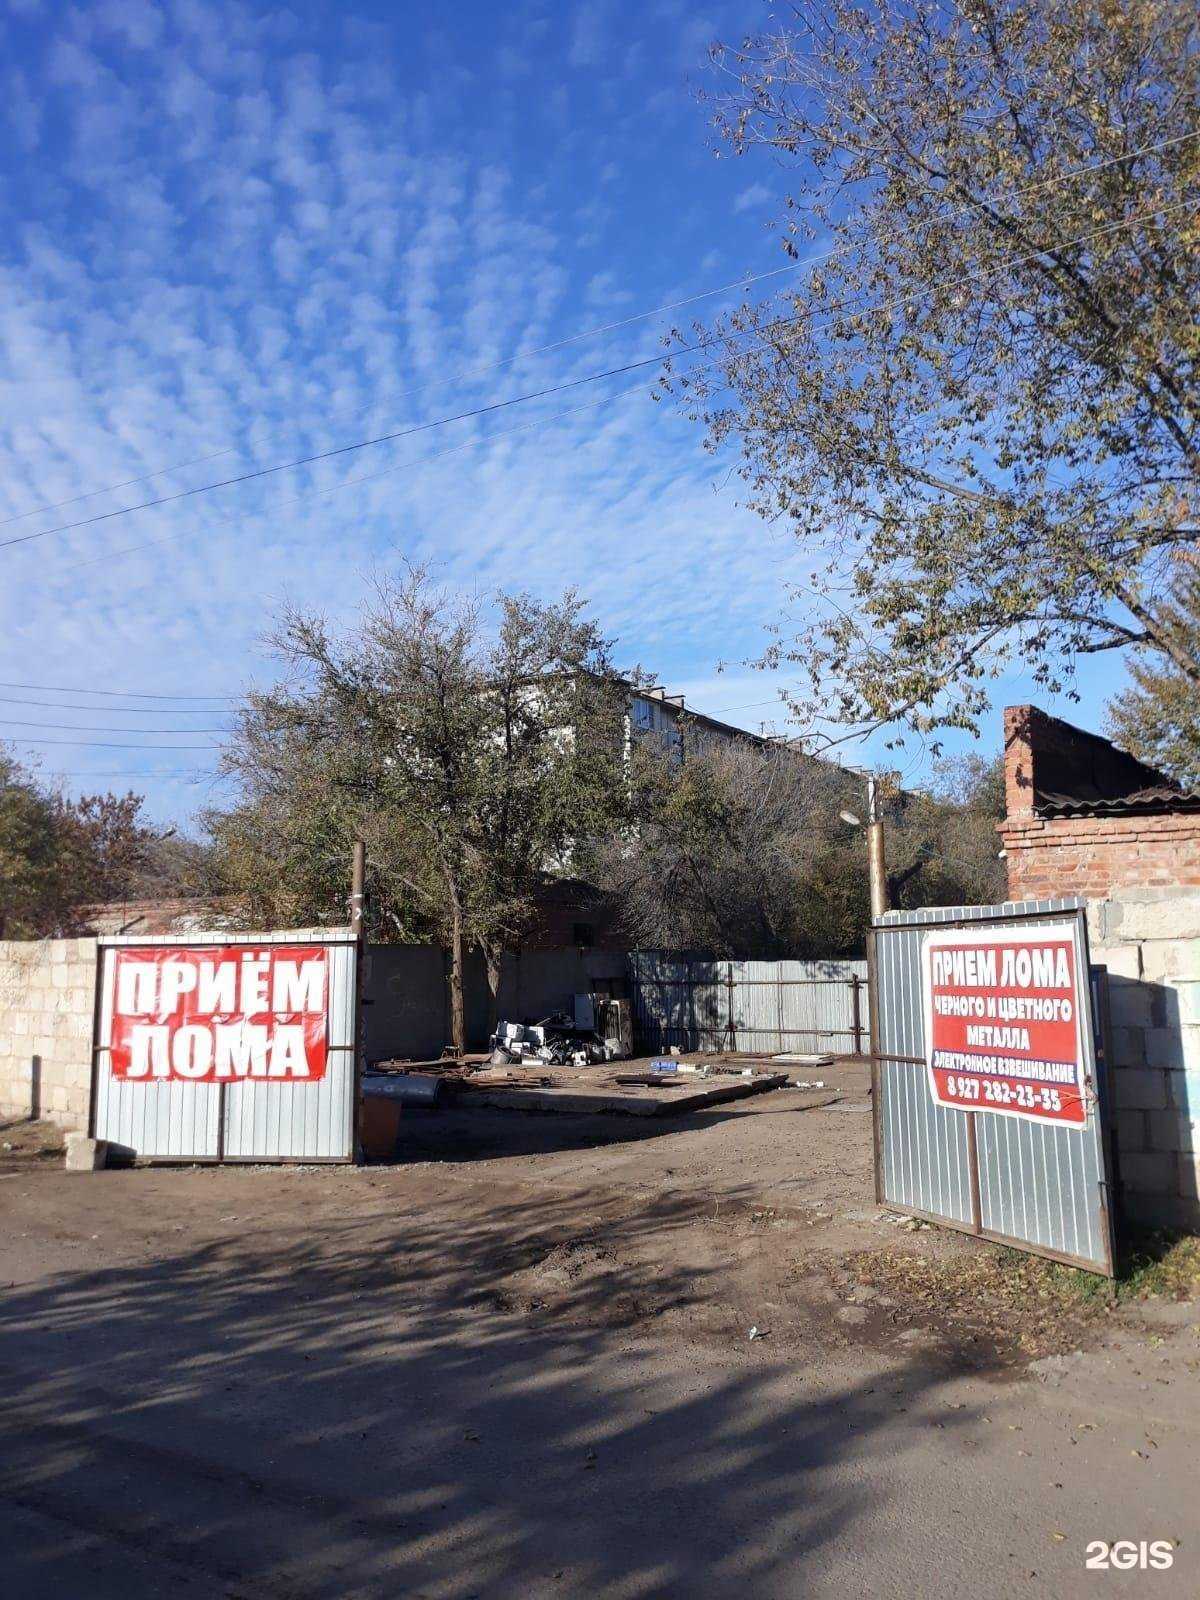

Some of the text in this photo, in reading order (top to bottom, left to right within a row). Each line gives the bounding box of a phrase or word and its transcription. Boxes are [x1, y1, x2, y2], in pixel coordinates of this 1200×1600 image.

[117, 952, 325, 1016] ПРИЁМ
[933, 948, 1071, 987] ПРИЕМ ЛОМА
[935, 995, 1072, 1022] ЧЕРНОГО И ЦВЕТНОГО
[127, 1023, 310, 1078] ЛОМА
[966, 1025, 1030, 1050] МЕТАЛЛА
[934, 1051, 1076, 1083] ЭЛЕКТРОННОЕ ВЗВЕШИВАНИЕ
[947, 1075, 1061, 1111] 8 927 282-23-35
